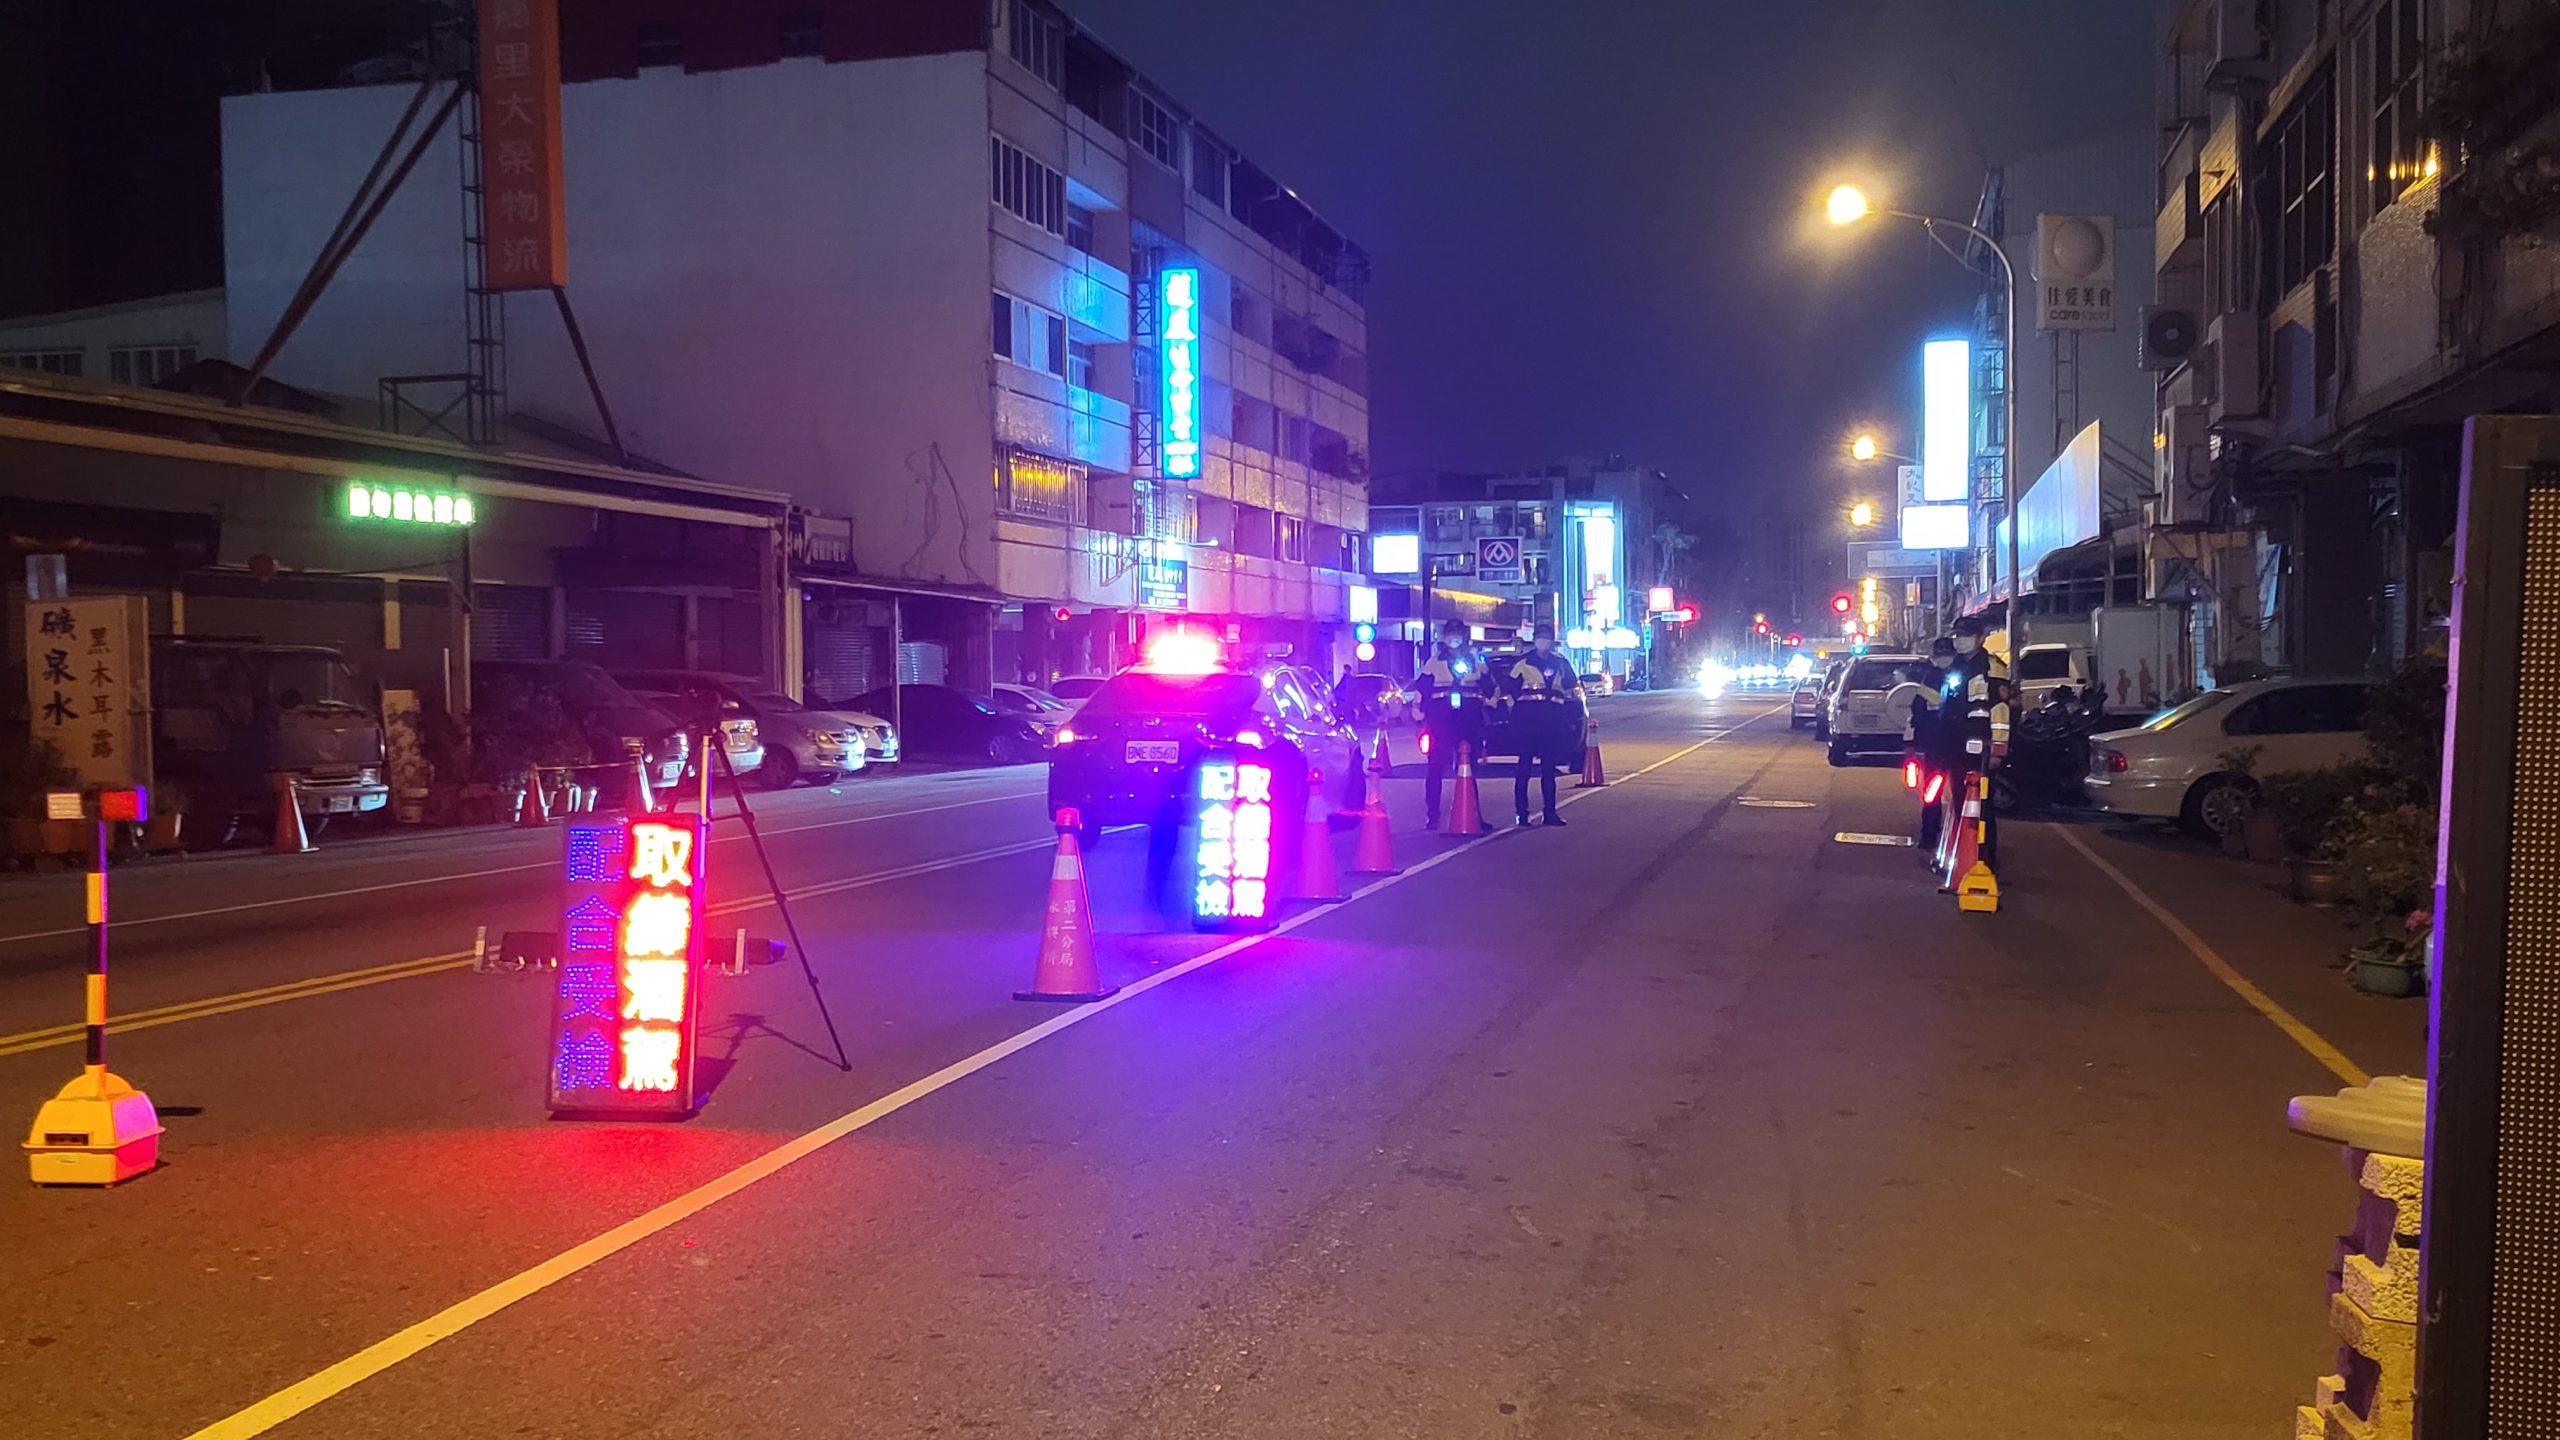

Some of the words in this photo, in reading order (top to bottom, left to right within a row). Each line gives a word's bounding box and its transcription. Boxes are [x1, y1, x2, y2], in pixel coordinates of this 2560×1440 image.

[40, 607, 80, 726] 礦泉水
[87, 627, 114, 759] 黑木耳露
[556, 826, 624, 1090] 配合受檢
[618, 822, 693, 1092] 取酒駕
